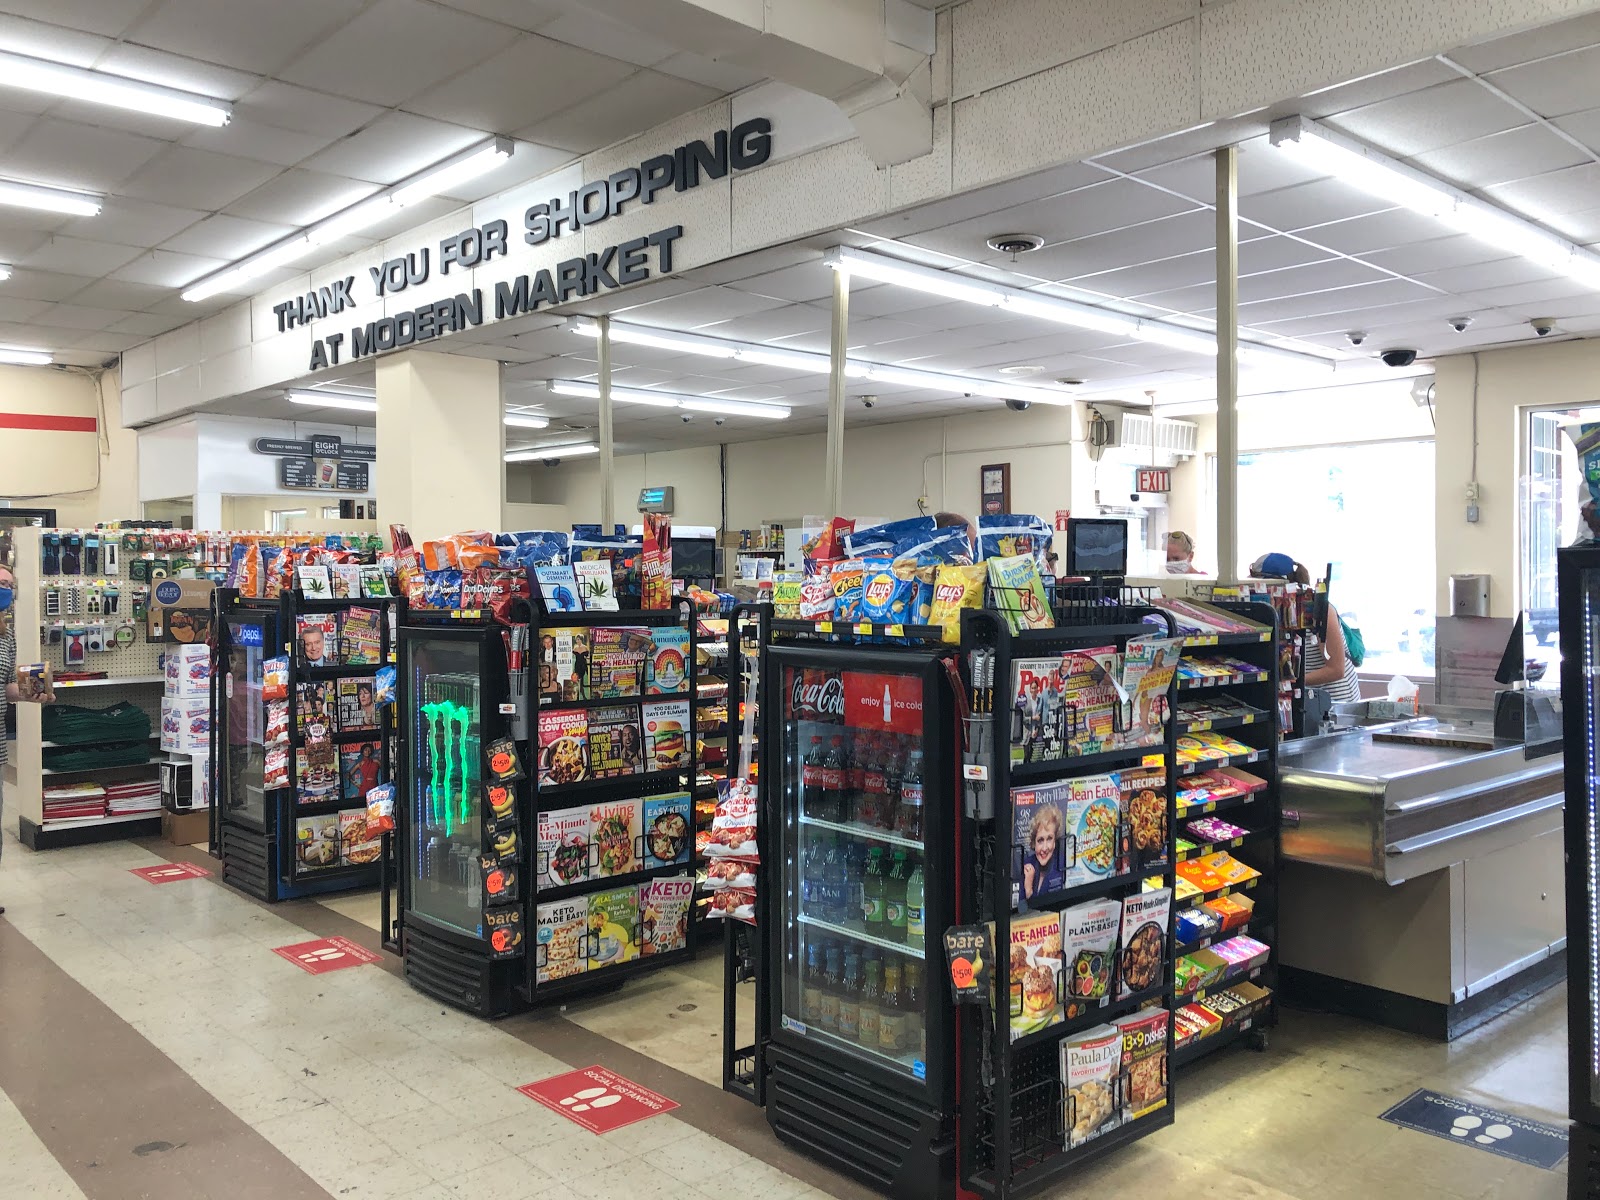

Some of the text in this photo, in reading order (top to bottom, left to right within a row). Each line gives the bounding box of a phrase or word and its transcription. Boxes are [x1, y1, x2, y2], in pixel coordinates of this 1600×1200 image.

[273, 117, 772, 333] THANK YOU FOR SHOPPING
[309, 225, 683, 370] AT MODERN MARKET
[315, 442, 339, 450] EIGHT
[1140, 471, 1168, 491] EXIT
[478, 585, 503, 594] Doritos
[867, 582, 893, 598] Lay's
[936, 585, 964, 602] Lay's
[242, 628, 260, 640] pepsi
[1078, 686, 1109, 698] SHORTCUT
[861, 696, 880, 707] enjoy
[906, 700, 922, 710] cold
[540, 713, 584, 725] CASSEROLES
[561, 720, 587, 729] COOKER
[1049, 711, 1057, 724] The
[1043, 725, 1055, 739] Side
[1050, 740, 1061, 750] the
[1132, 777, 1166, 789] RECIPES
[904, 788, 922, 799] Coke
[1035, 791, 1052, 805] Betty
[1096, 785, 1120, 801] Eating
[599, 803, 634, 820] Living
[648, 804, 688, 817] EASY KETO
[1020, 808, 1030, 816] 98
[539, 818, 588, 831] 15-Minute
[539, 830, 568, 841] Meals
[612, 892, 632, 900] SIMPLE
[652, 882, 693, 896] KETO
[553, 907, 574, 916] KETO
[1126, 902, 1142, 914] KETO
[1143, 900, 1154, 911] Made
[486, 911, 519, 926] bare
[538, 910, 587, 926] MADE EASY!
[1069, 920, 1118, 936] PLANT-BASED
[947, 935, 984, 949] bare
[1145, 1026, 1166, 1046] DISHES
[1071, 1049, 1100, 1066] Paula
[1071, 1068, 1095, 1077] FAVORITE
[584, 1070, 611, 1087] SOCIAL
[612, 1085, 662, 1110] DISTANCING
[600, 1070, 616, 1080] THANK
[617, 1078, 627, 1086] YOU
[636, 1087, 666, 1103] PRACTICING
[1424, 1096, 1569, 1141] SOCIAL DISTANCING
